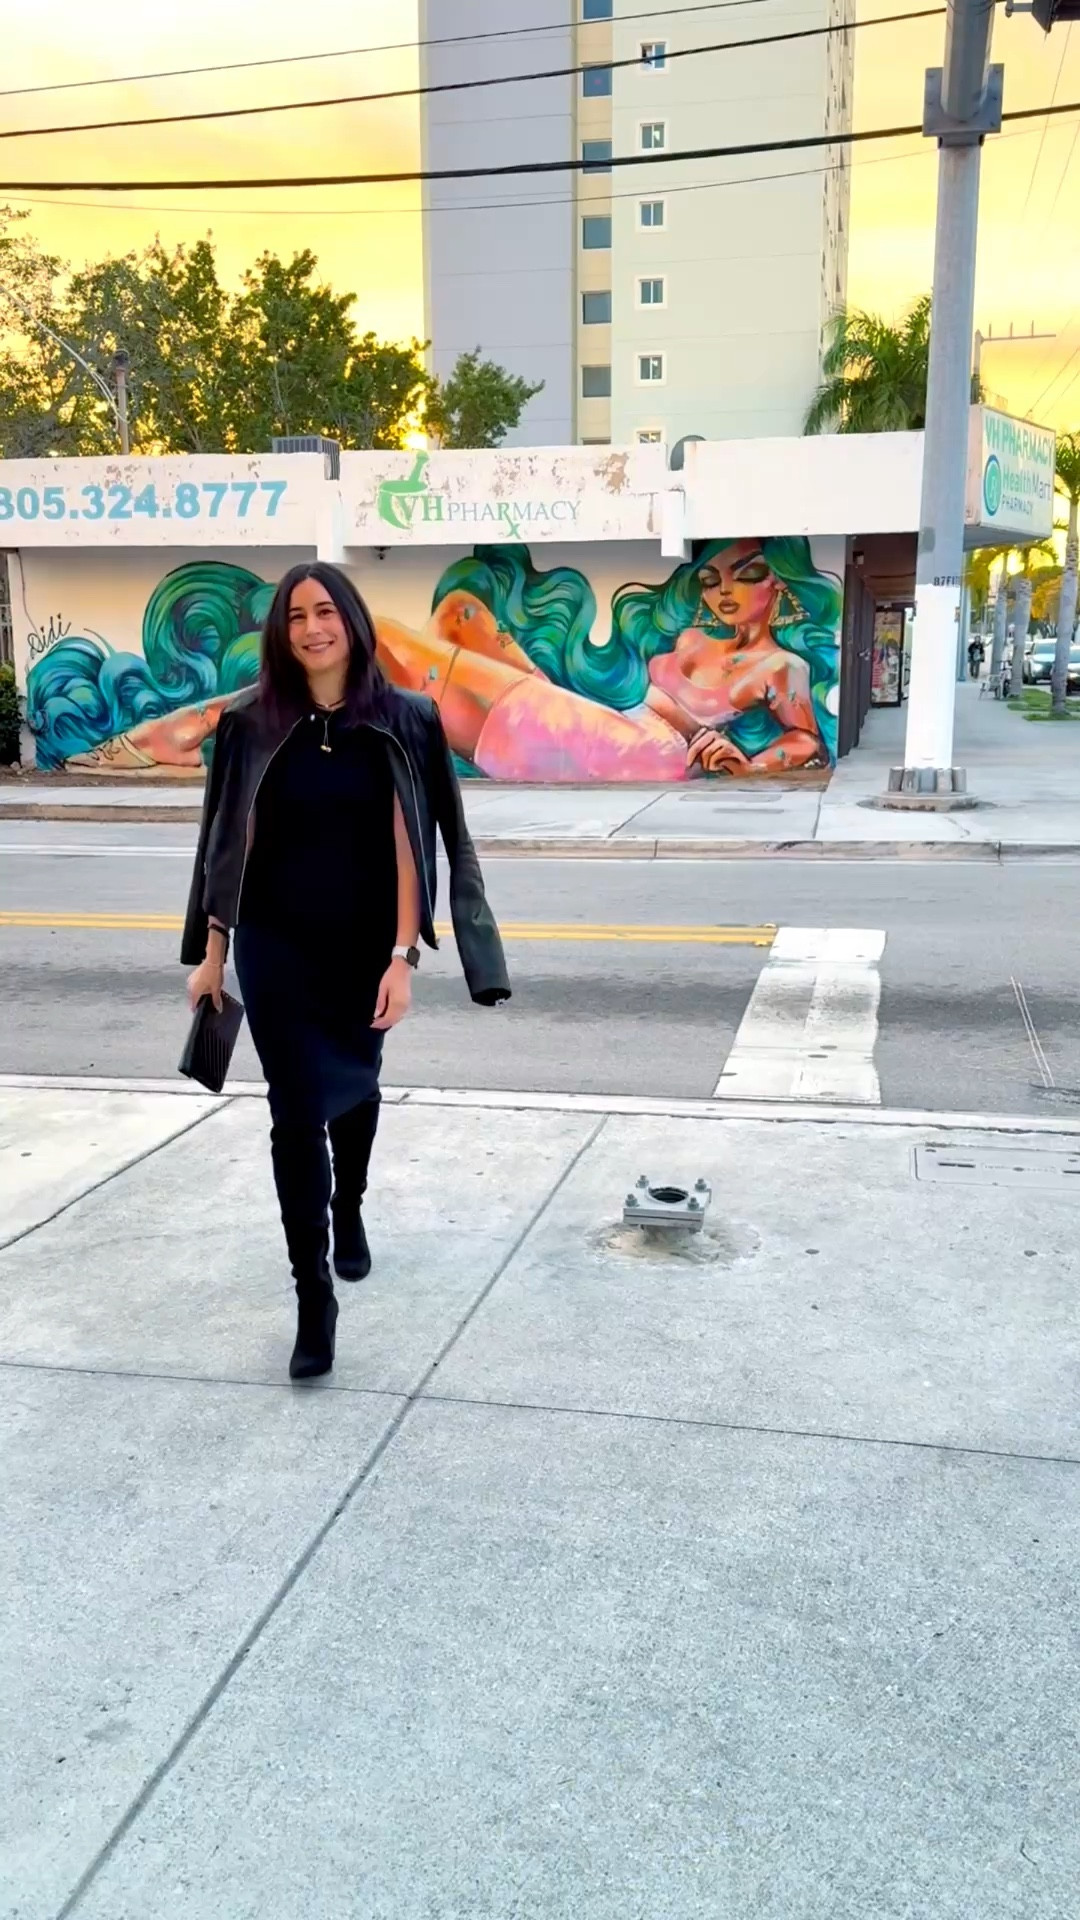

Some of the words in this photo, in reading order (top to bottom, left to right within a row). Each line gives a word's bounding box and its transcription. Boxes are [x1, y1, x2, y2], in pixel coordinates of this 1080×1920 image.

[1001, 421, 1053, 467] PHARMACY
[396, 495, 444, 521] VH
[447, 500, 581, 522] PHARMACY
